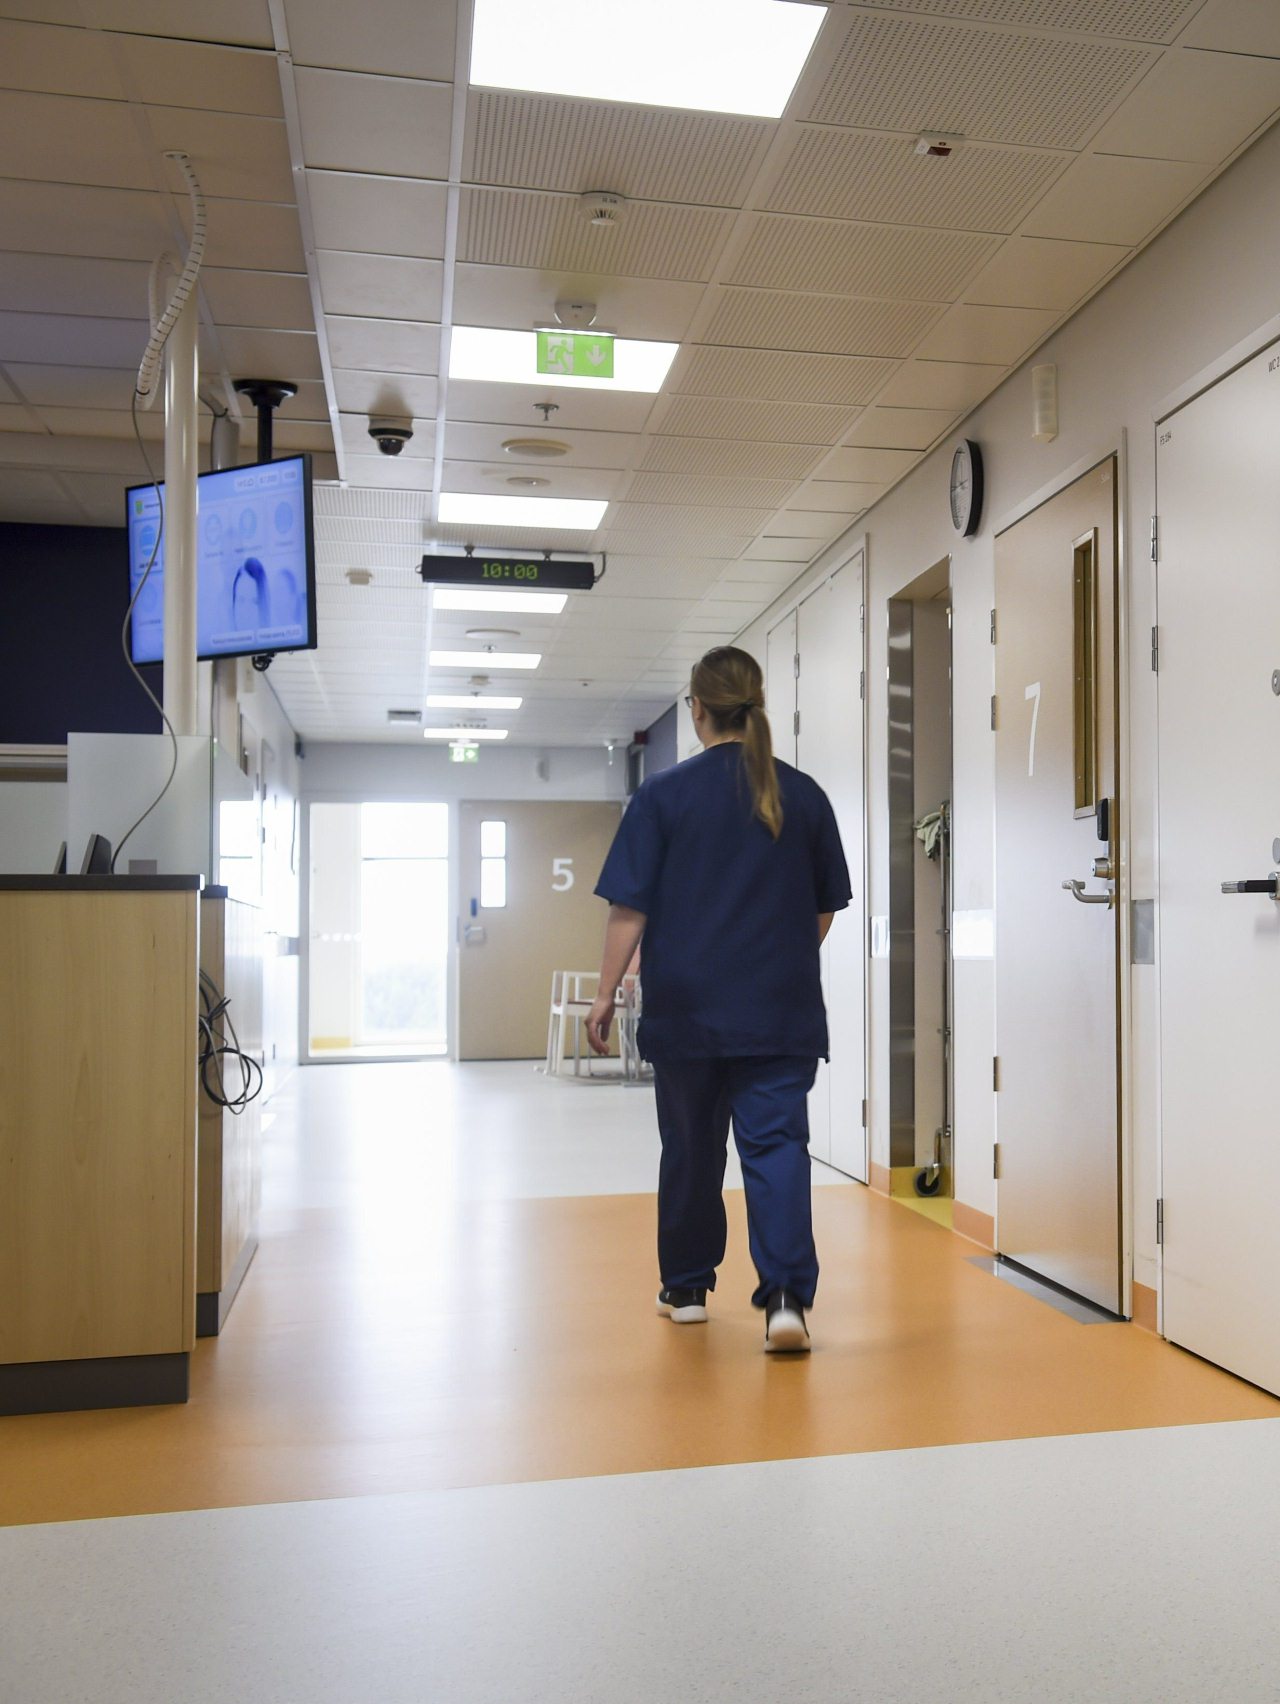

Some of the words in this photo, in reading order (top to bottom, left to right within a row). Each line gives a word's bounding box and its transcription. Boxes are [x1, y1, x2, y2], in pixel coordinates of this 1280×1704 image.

[1268, 358, 1276, 372] WC
[482, 563, 538, 580] 10:00
[1025, 681, 1041, 777] 7
[552, 858, 574, 891] 5
